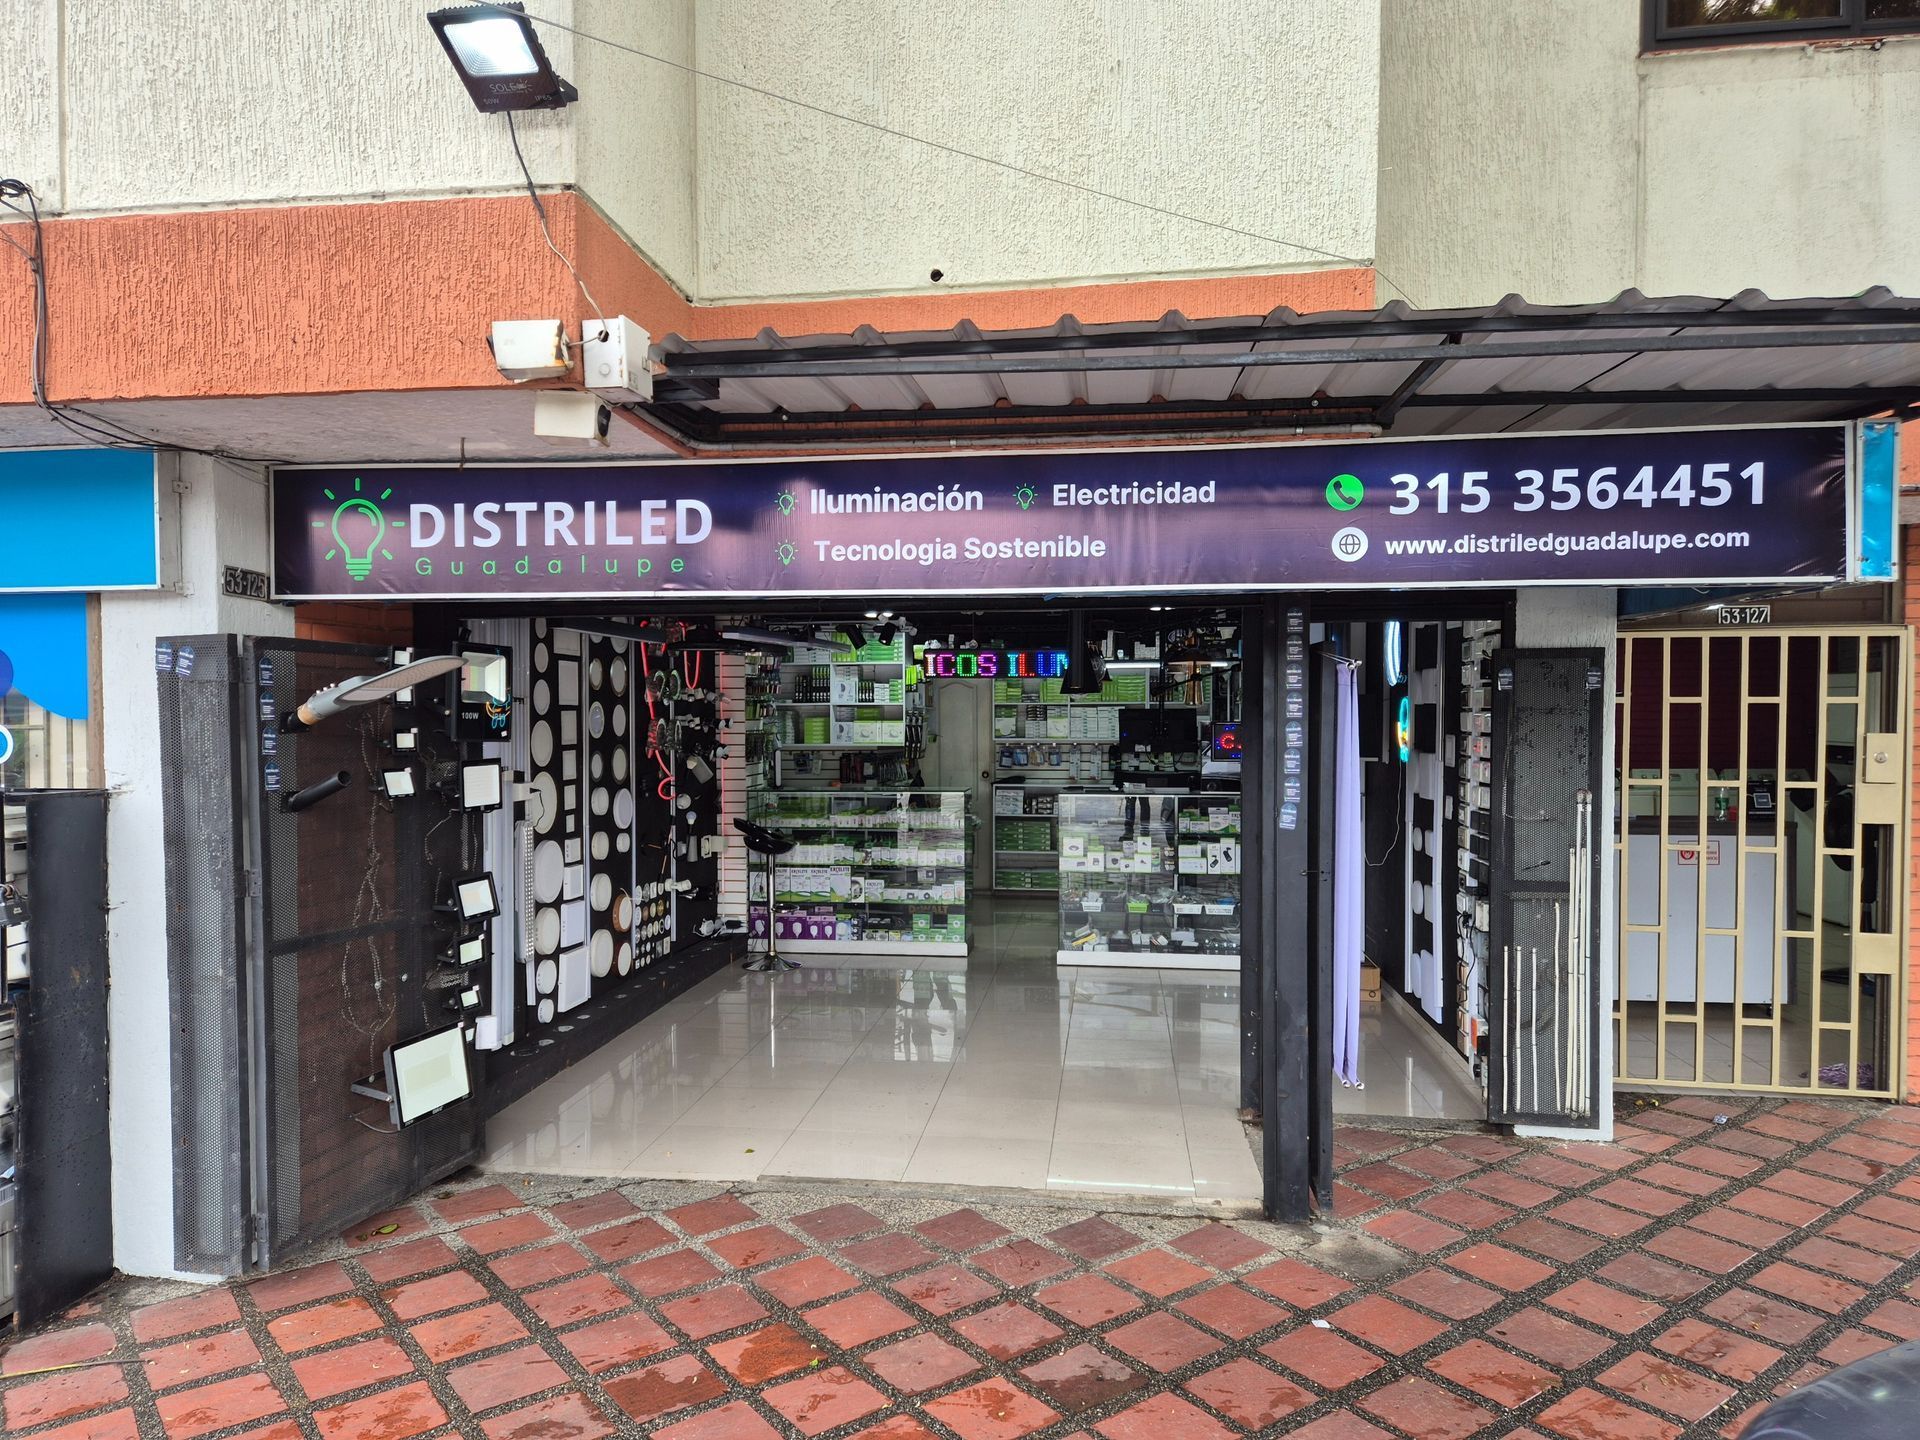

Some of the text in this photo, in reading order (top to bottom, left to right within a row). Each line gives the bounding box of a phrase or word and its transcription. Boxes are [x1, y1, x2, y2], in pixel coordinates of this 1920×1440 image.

[810, 483, 983, 515] Iluminación
[1053, 480, 1216, 506] Electricidad
[1389, 461, 1764, 515] 315 3564451
[410, 499, 713, 549] DISTRILED
[812, 534, 1107, 566] Tecnologia Sostenible
[1384, 530, 1750, 556] www.distriledguadalupe.com
[416, 556, 685, 577] Guadalupe
[925, 653, 997, 677] ICOS
[461, 712, 479, 720] 100W
